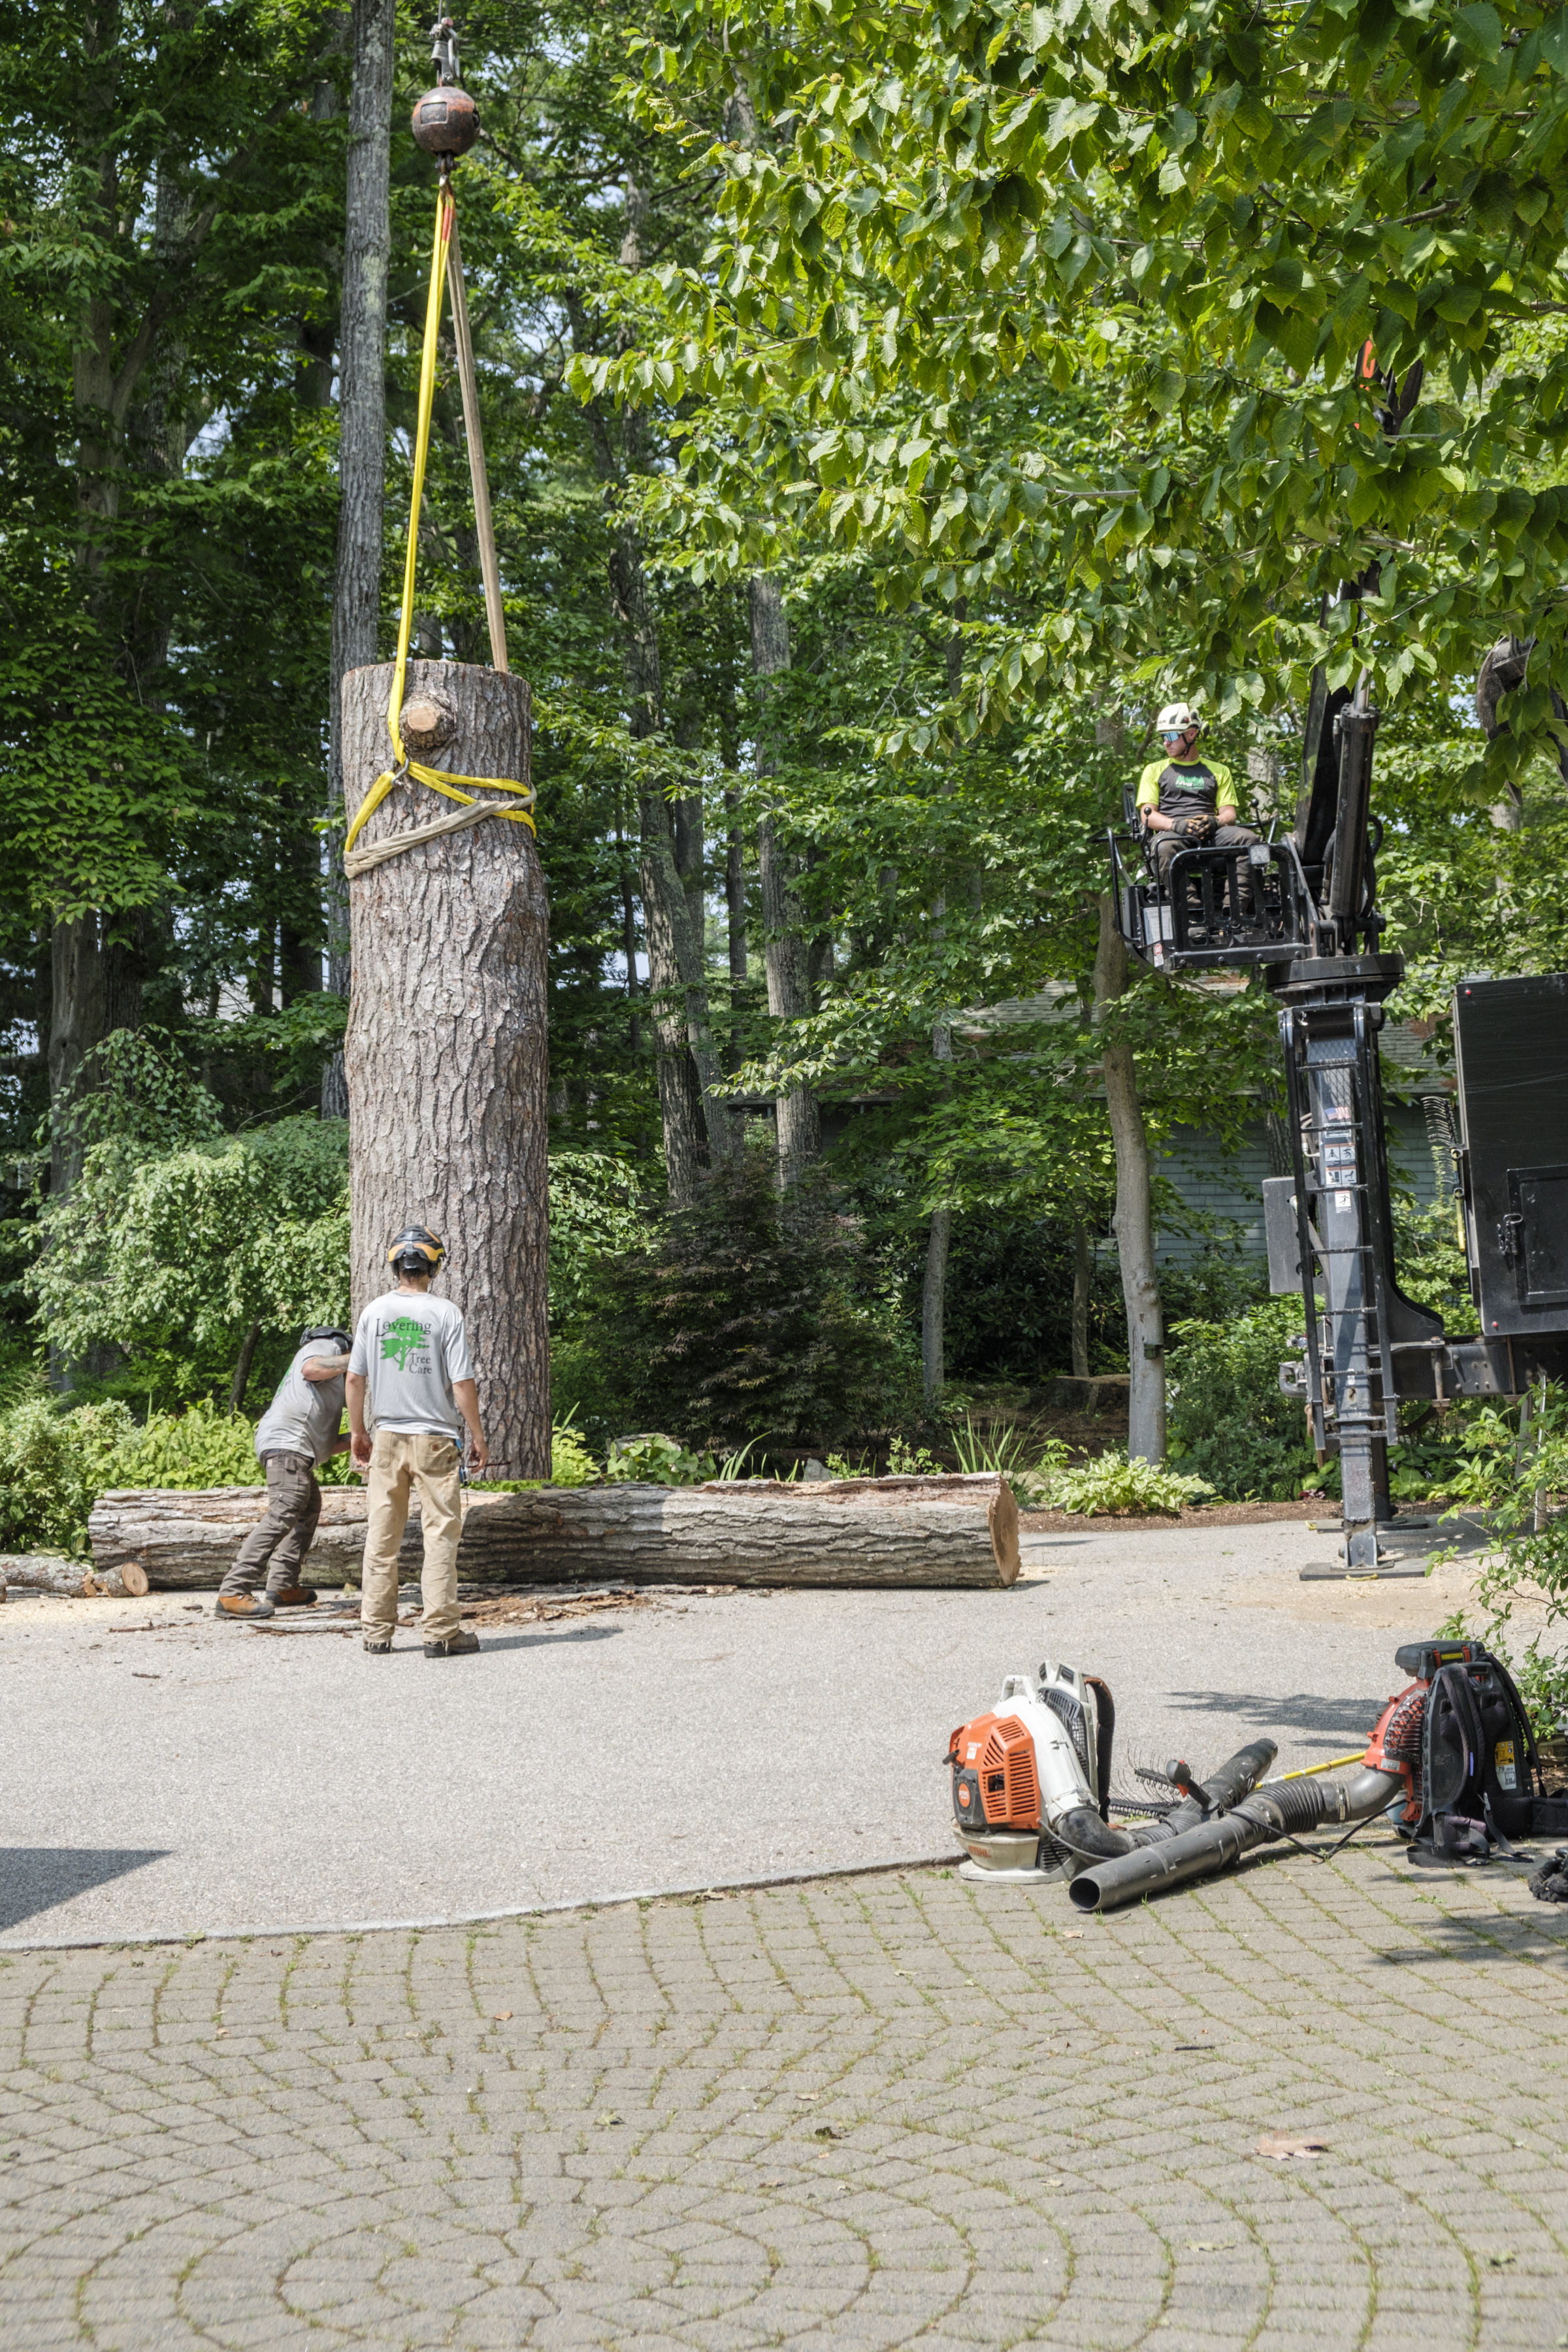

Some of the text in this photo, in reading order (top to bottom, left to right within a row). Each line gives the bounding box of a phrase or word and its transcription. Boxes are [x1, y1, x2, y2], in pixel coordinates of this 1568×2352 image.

[376, 1318, 431, 1337] Lovering
[409, 1353, 431, 1364] Tree
[409, 1364, 433, 1374] Care
[968, 1844, 992, 1858] STIHL
